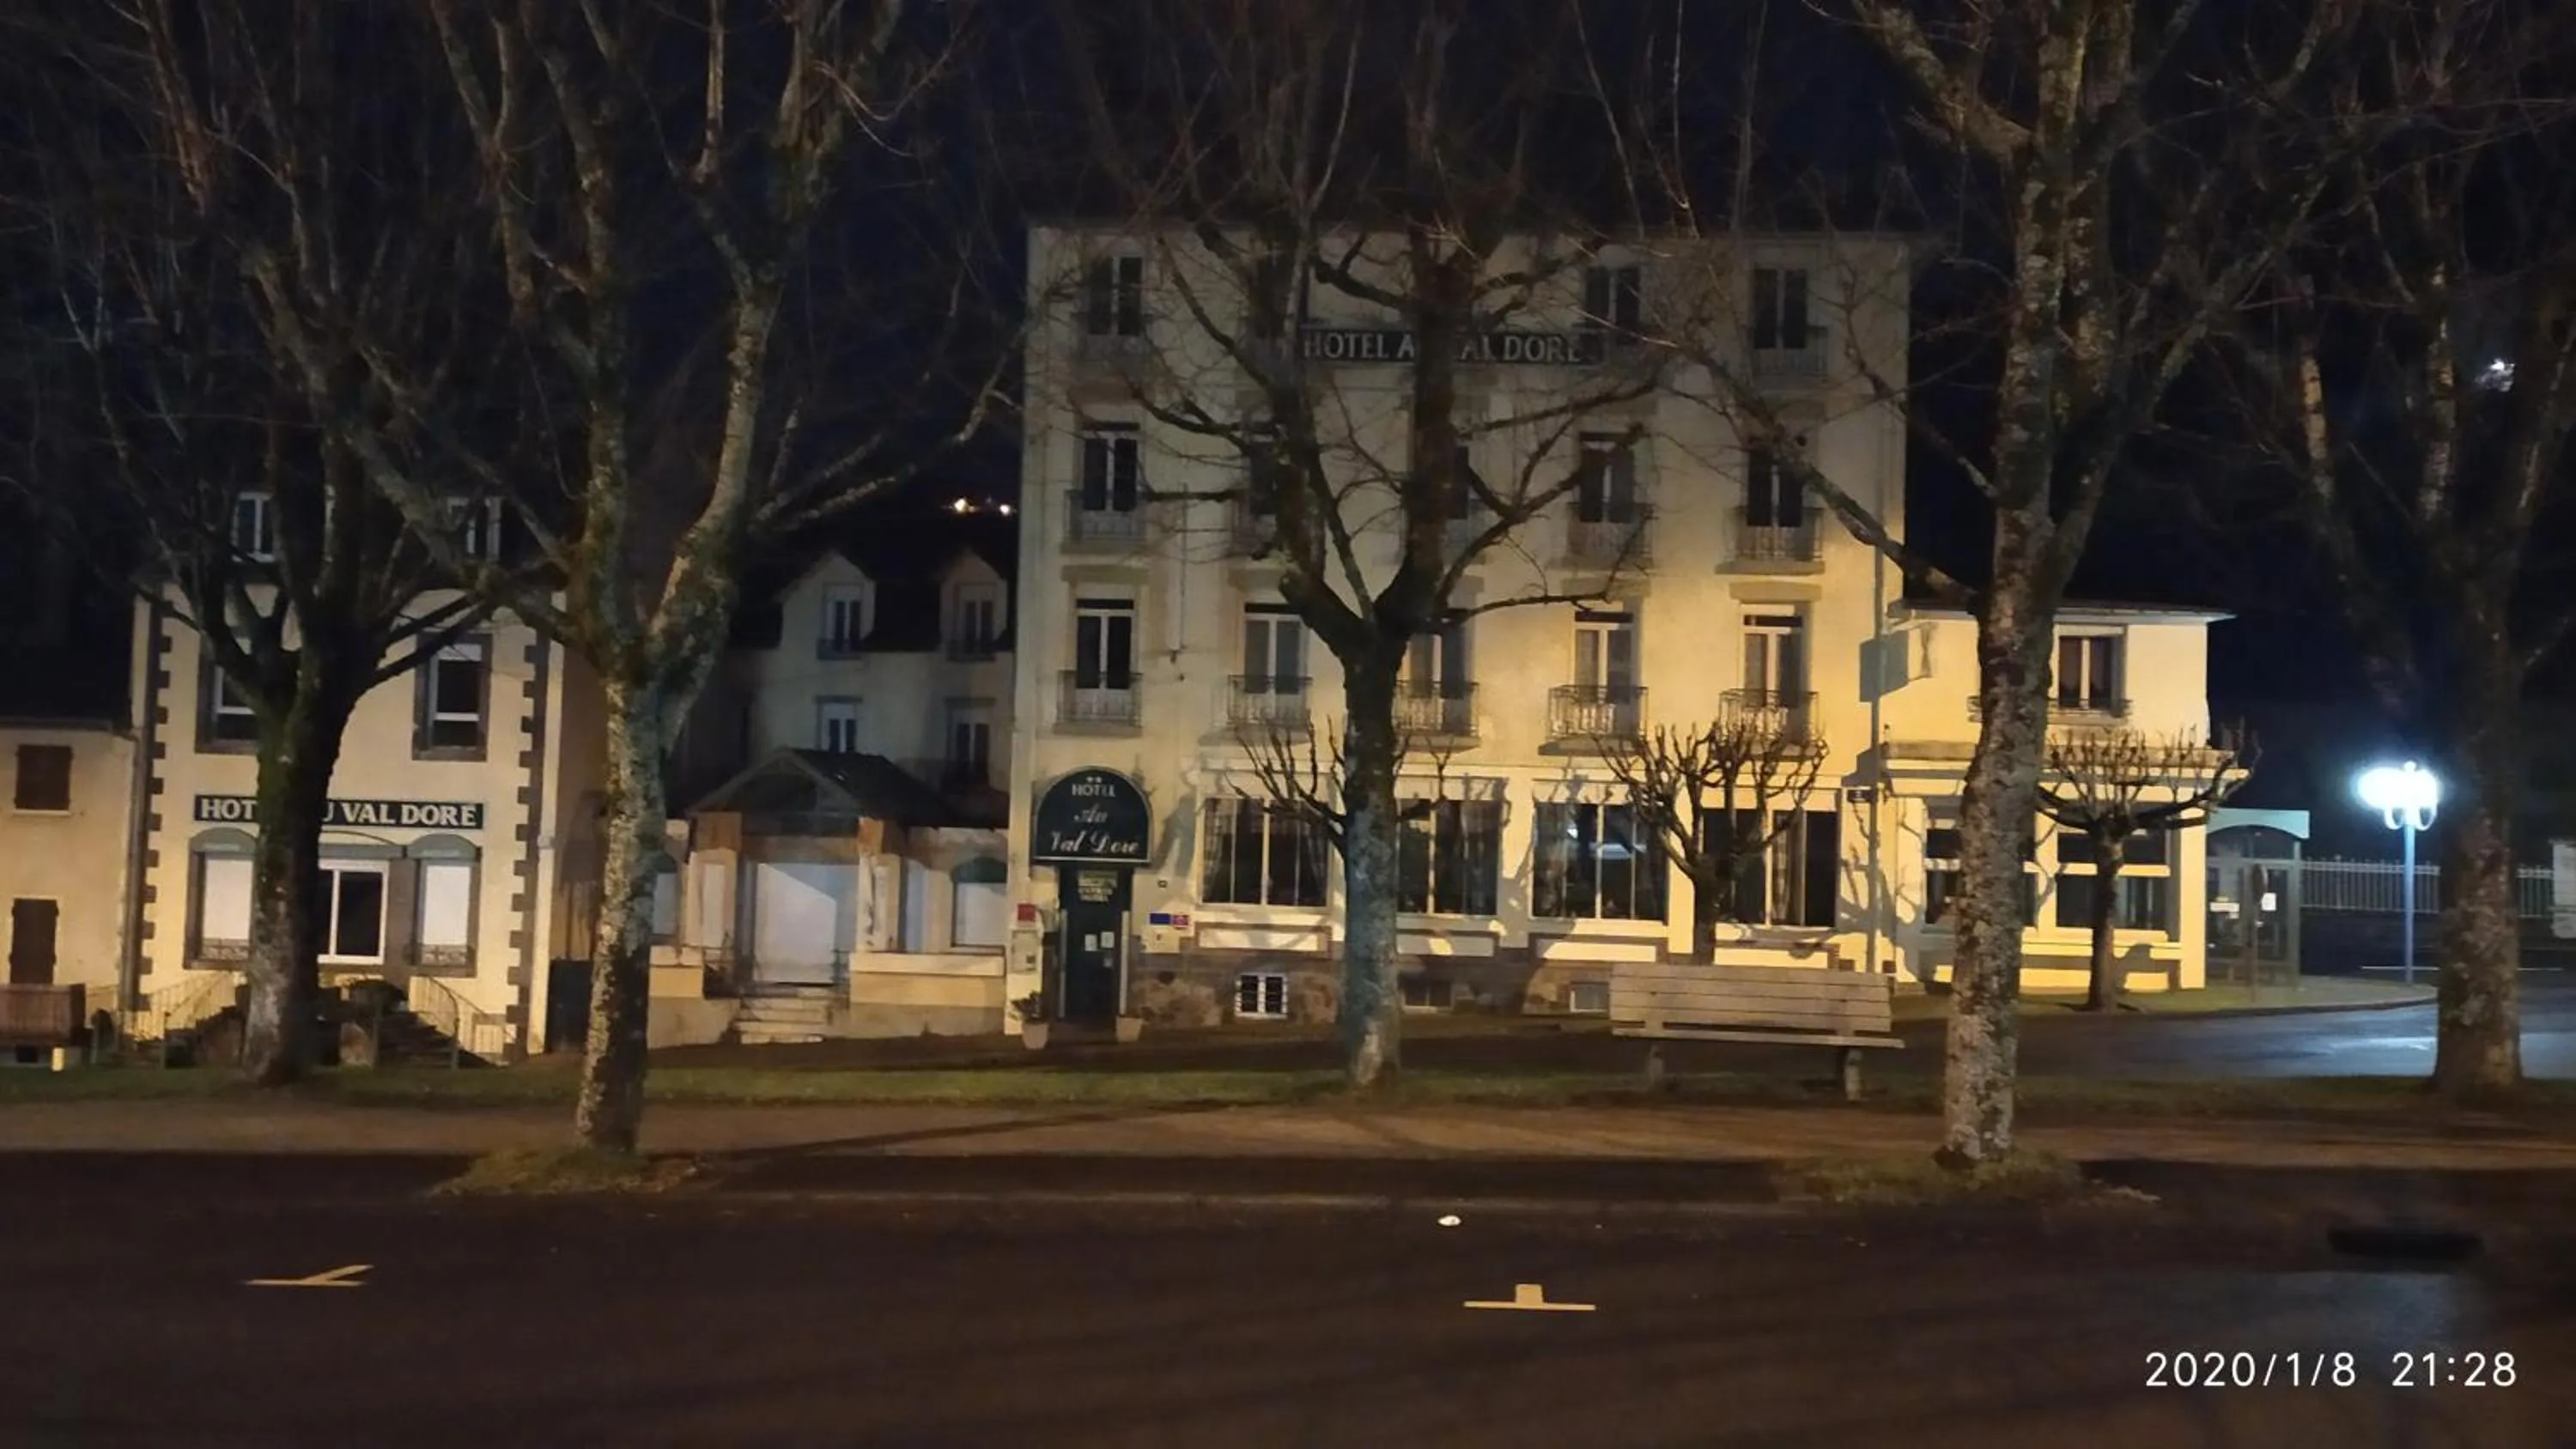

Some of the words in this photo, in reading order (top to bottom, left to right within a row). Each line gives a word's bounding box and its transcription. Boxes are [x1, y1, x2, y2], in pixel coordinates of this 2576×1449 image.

[1303, 332, 1389, 359] HOTEL
[199, 797, 260, 821] HOT
[342, 802, 397, 825] VAL
[400, 803, 477, 827] DORE
[1050, 830, 1086, 852] Val
